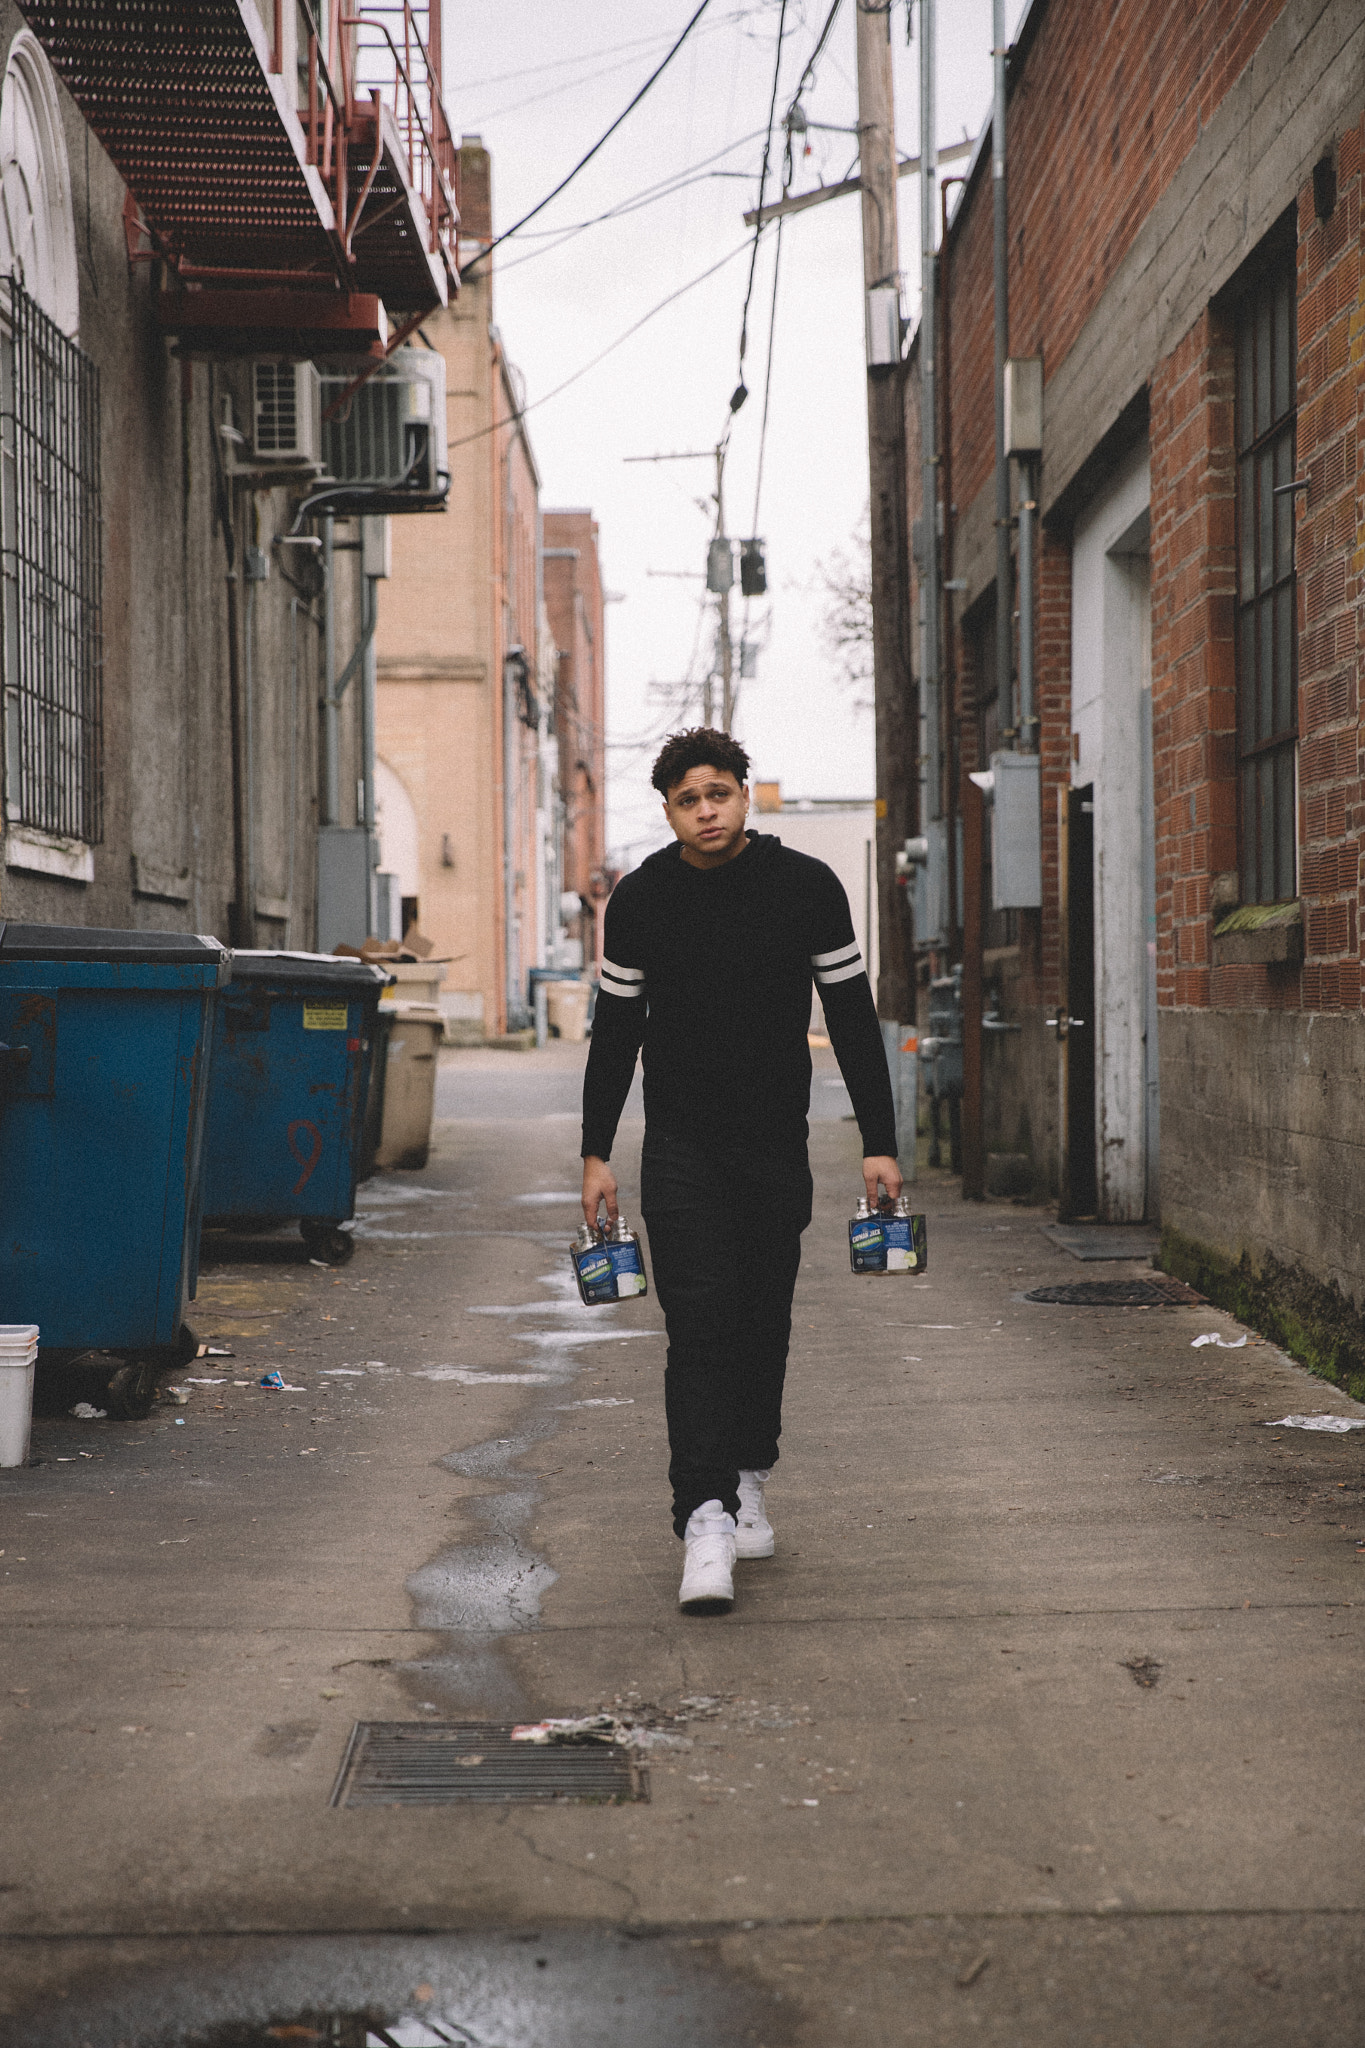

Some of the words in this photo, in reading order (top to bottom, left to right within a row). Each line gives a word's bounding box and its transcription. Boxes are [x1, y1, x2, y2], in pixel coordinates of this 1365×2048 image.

[287, 1118, 323, 1196] 9
[869, 1228, 881, 1237] JACK
[596, 1258, 608, 1268] JACK
